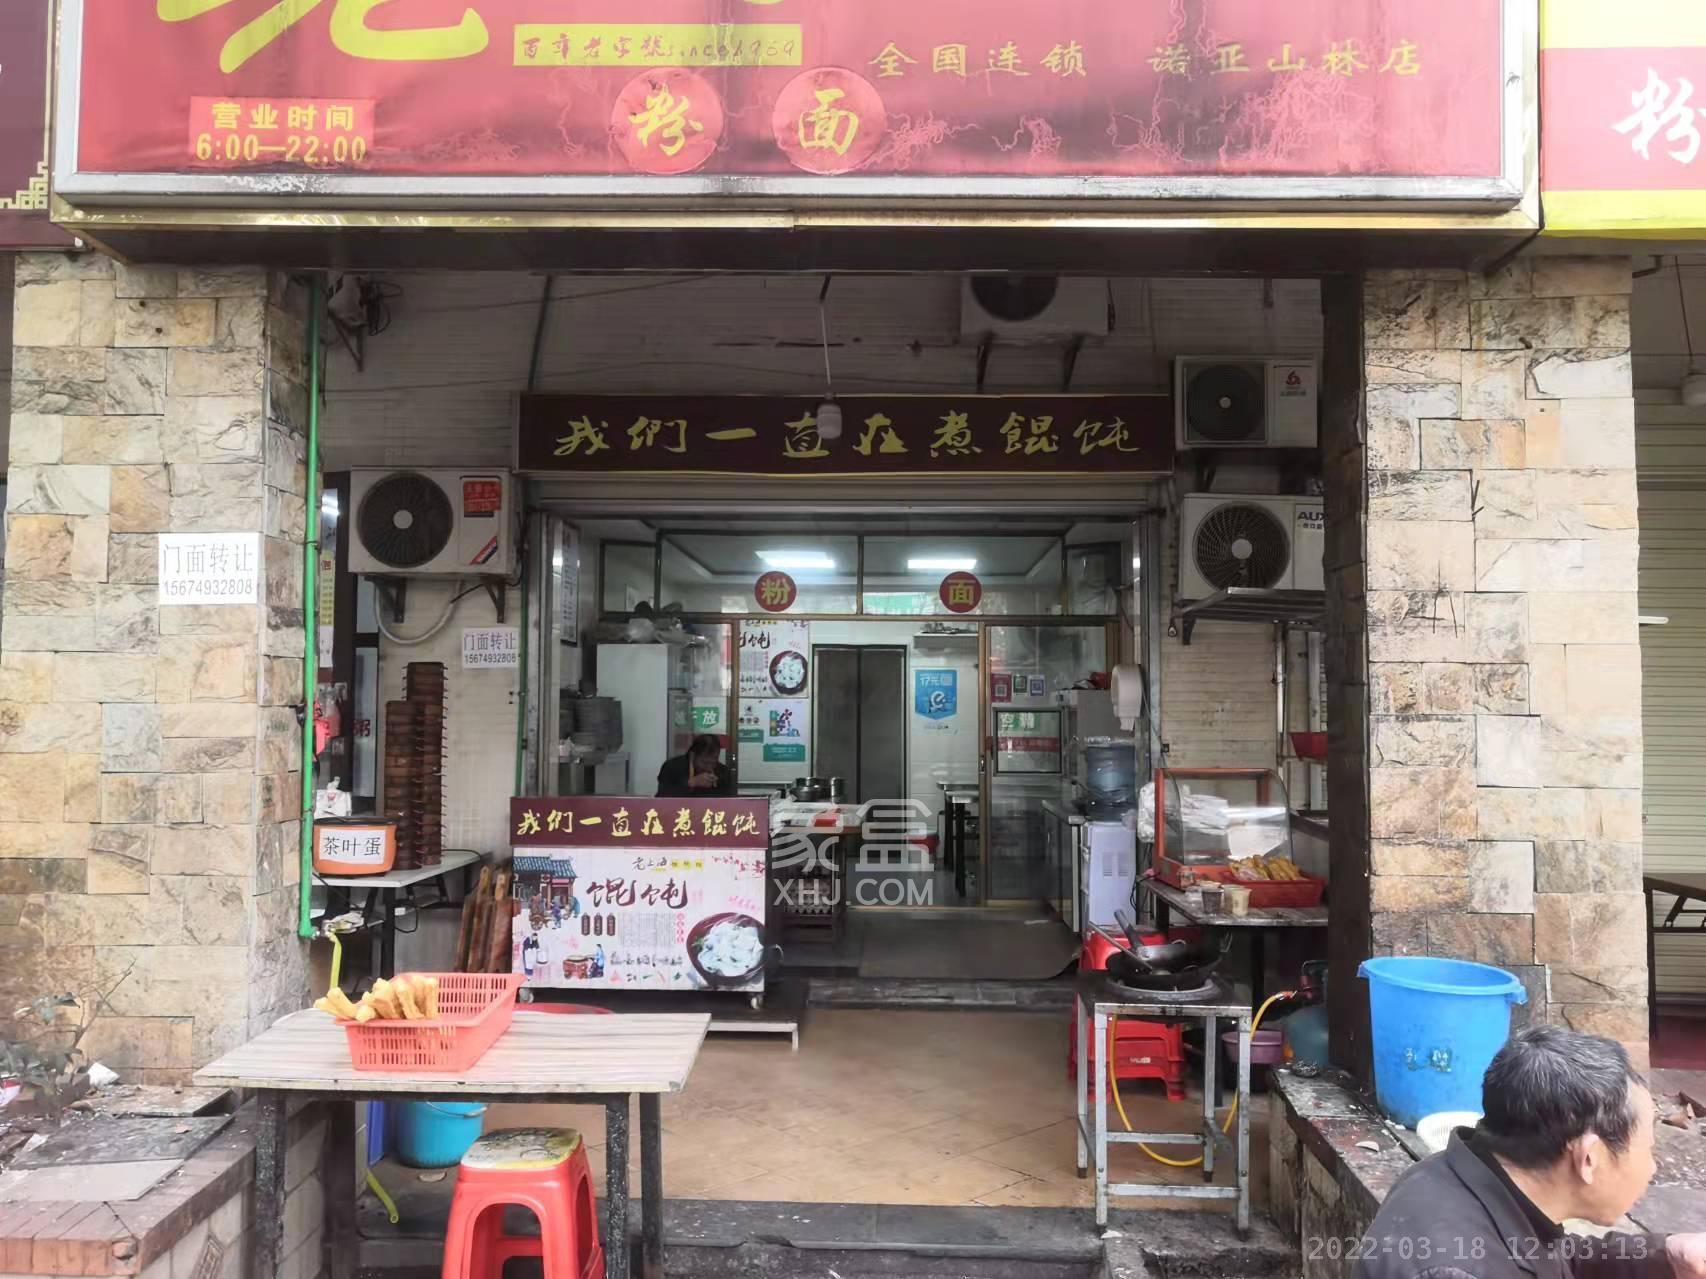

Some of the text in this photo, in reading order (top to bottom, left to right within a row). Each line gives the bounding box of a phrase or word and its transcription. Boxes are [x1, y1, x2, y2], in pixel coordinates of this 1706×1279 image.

[867, 40, 1087, 77] 全国连锁
[211, 102, 354, 131] 营业时间
[628, 82, 859, 157] 粉 面
[1609, 66, 1706, 164] 粉
[163, 543, 253, 576] 门面转让
[164, 578, 252, 596] 15674932808
[761, 579, 976, 605] 粉 面
[464, 632, 517, 651] 门面转让
[323, 836, 382, 856] 茶叶蛋
[586, 877, 688, 909] 馄饨
